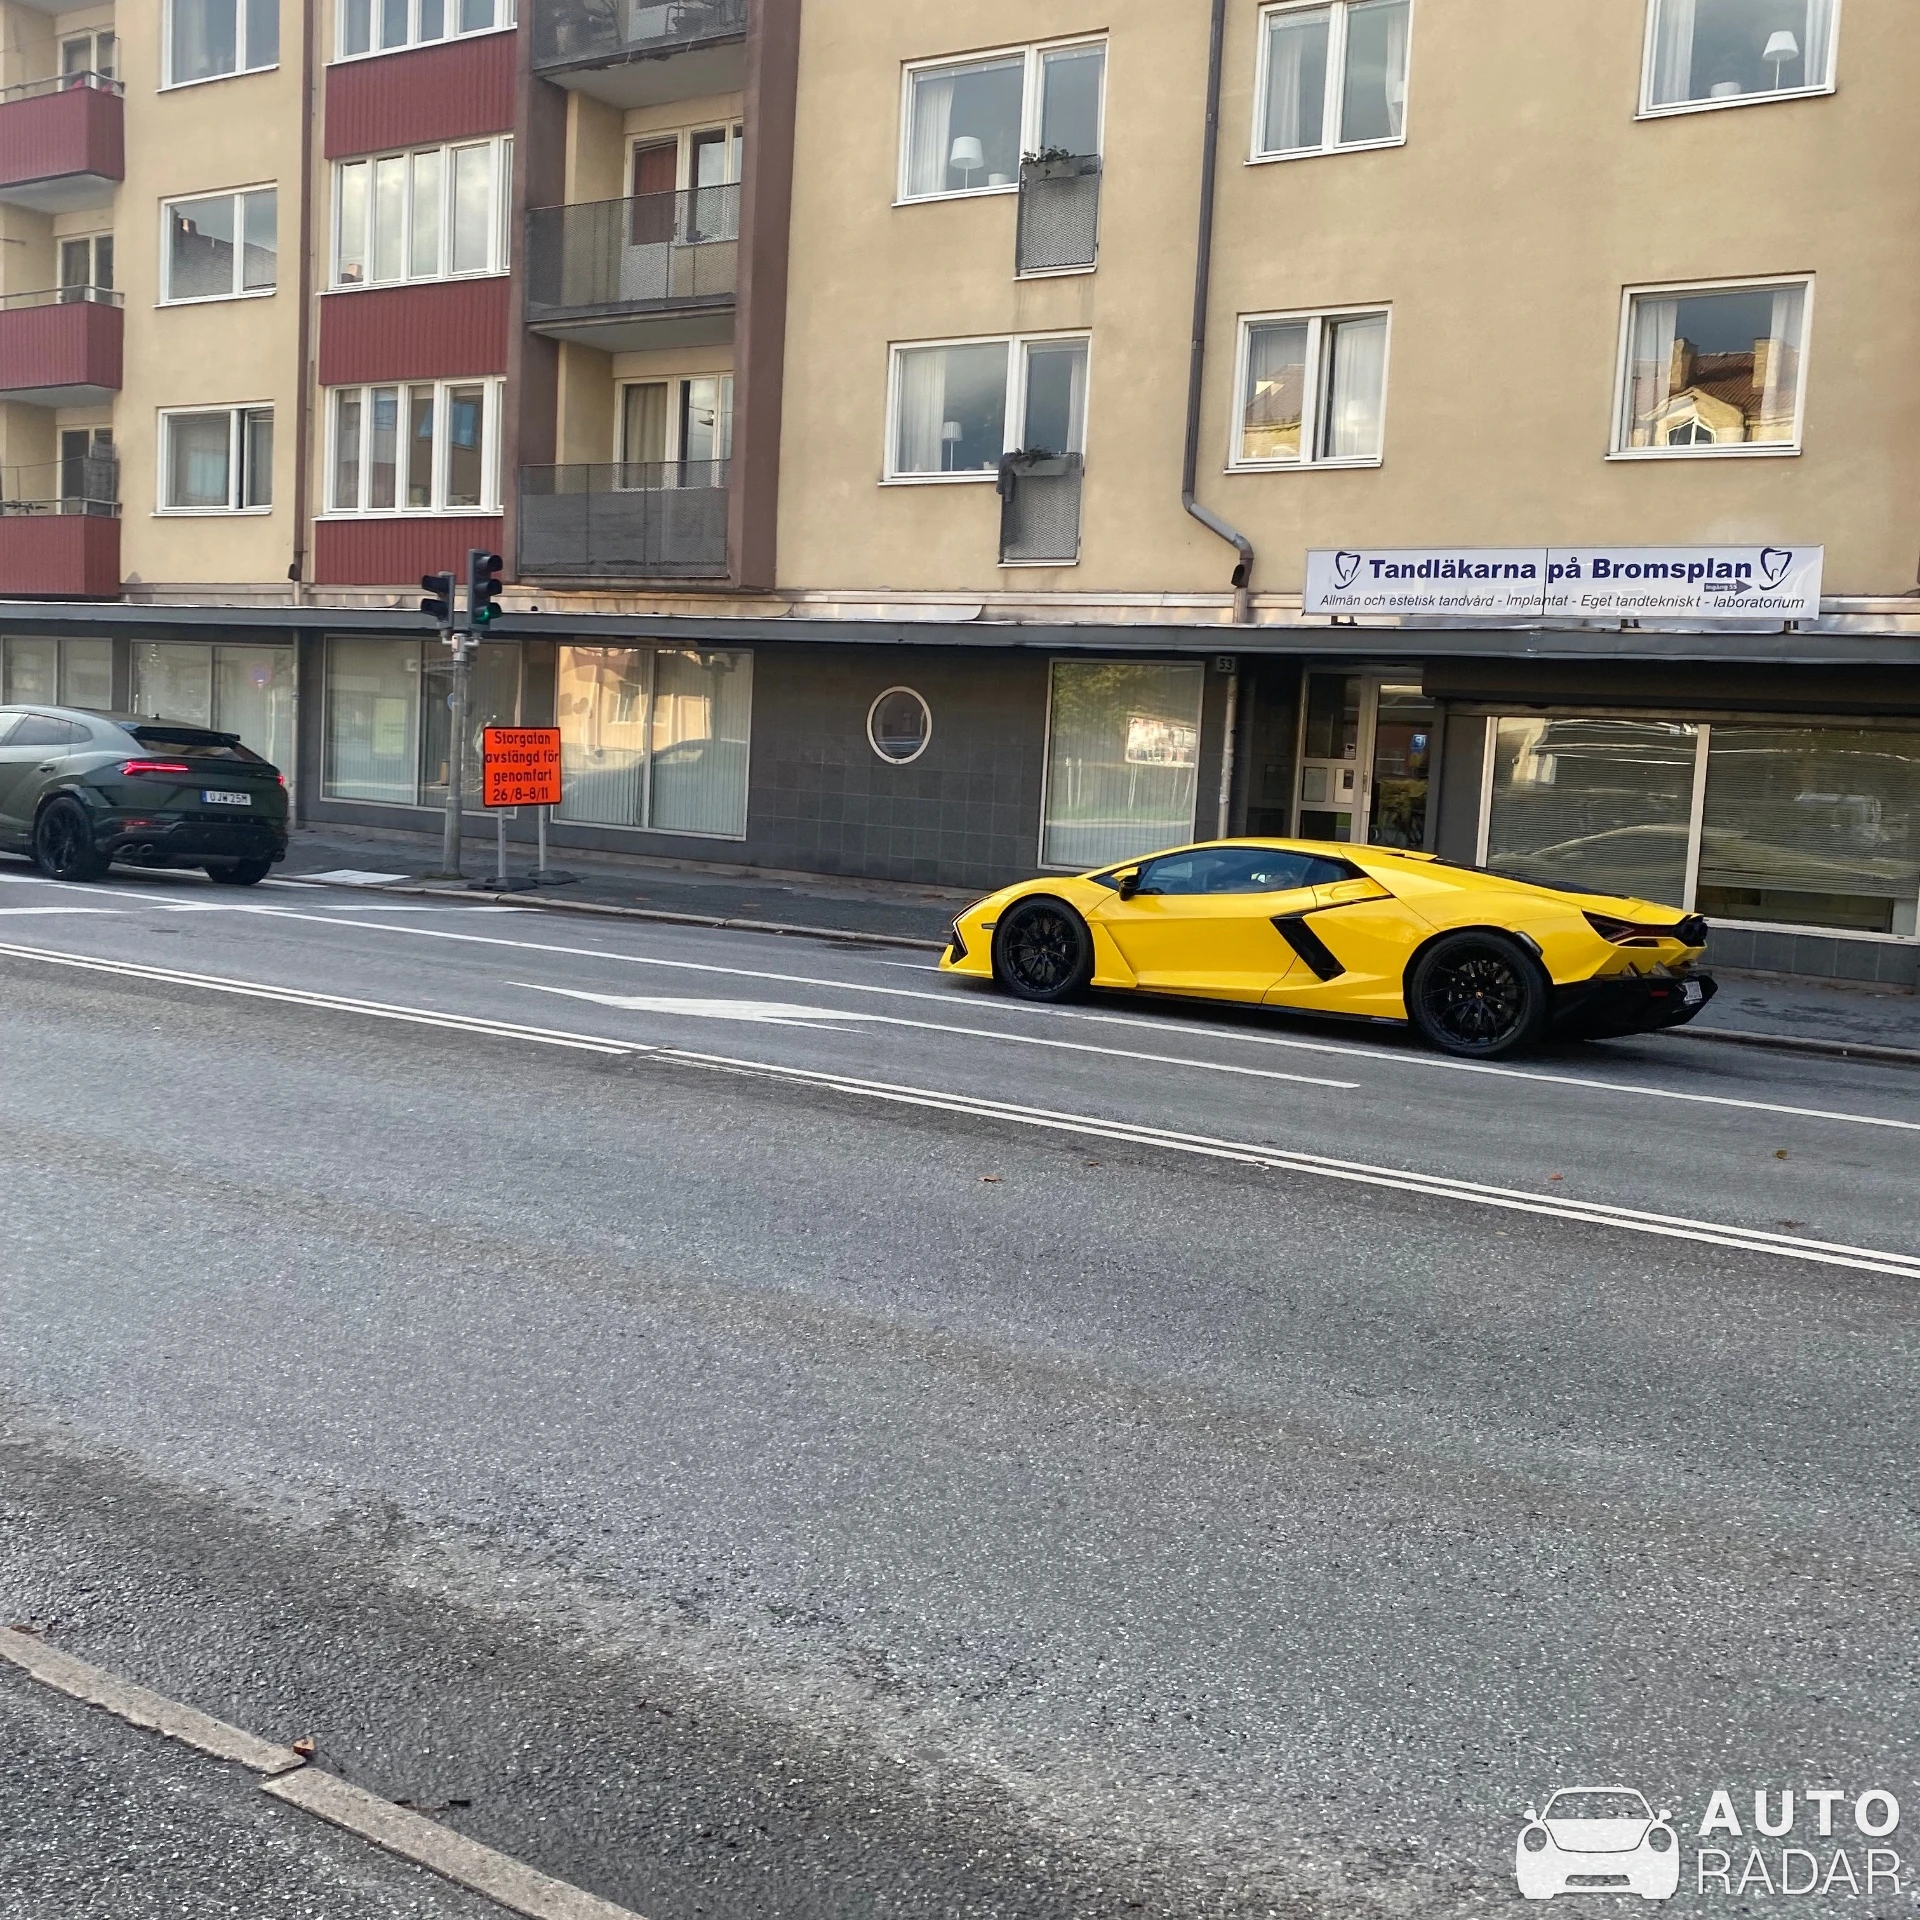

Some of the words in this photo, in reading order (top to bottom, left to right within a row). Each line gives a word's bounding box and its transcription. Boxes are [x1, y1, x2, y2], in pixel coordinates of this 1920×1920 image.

[1369, 559, 1536, 579] Tandläkarna
[1547, 557, 1581, 583] på
[1592, 558, 1751, 583] Bromsplan
[1320, 594, 1361, 606] Allmän
[1364, 595, 1386, 606] och
[1389, 595, 1436, 606] estetisk
[1438, 595, 1494, 607] tandvård
[1506, 594, 1568, 608] Implantat
[1580, 594, 1612, 609] Eget
[1713, 595, 1805, 608] laboratorium
[1219, 658, 1233, 670] 53
[494, 731, 551, 748] Storgatan
[485, 750, 540, 766] avstängd
[543, 750, 559, 763] för
[493, 769, 552, 785] genomfart
